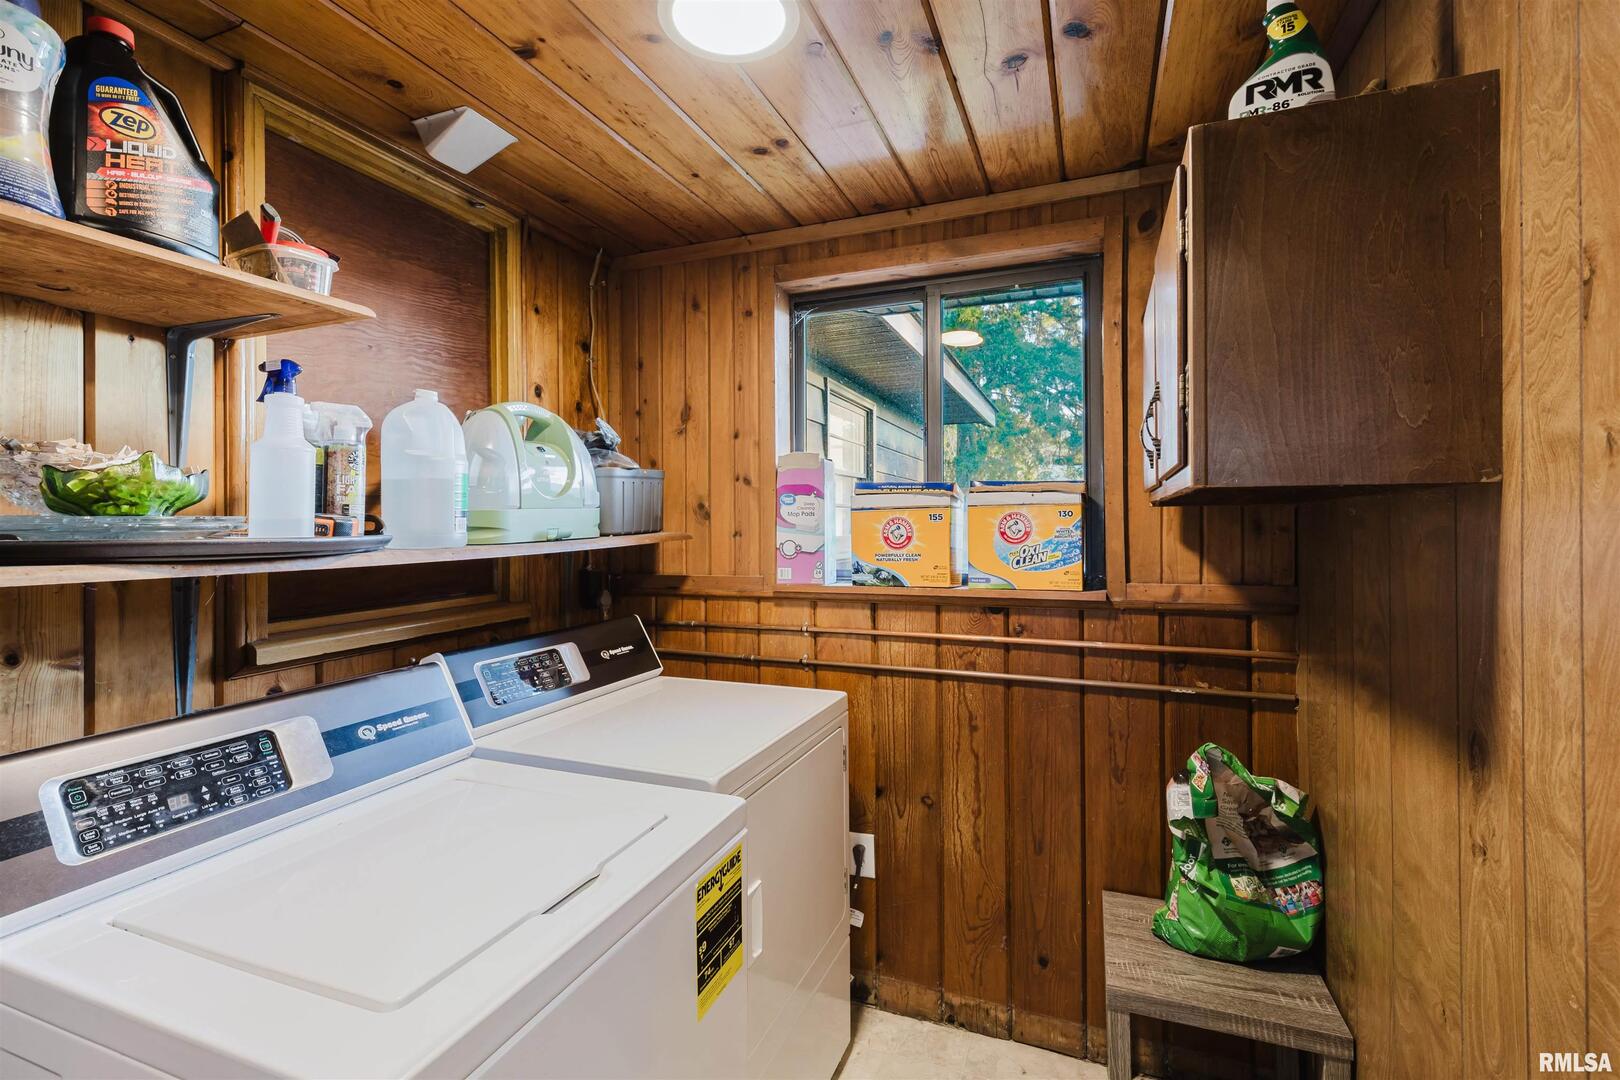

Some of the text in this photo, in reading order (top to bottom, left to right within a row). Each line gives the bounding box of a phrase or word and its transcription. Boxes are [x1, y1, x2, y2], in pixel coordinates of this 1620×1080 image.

[1281, 21, 1295, 33] 15
[1297, 62, 1316, 70] GRADE
[95, 85, 138, 97] GUARANTEED
[1245, 67, 1325, 106] RMR
[106, 138, 177, 159] LIQUID
[105, 153, 175, 174] HEAT
[928, 513, 943, 521] 155
[1019, 544, 1041, 558] OXI
[1011, 551, 1048, 569] CLEAN
[376, 718, 403, 731] Speed
